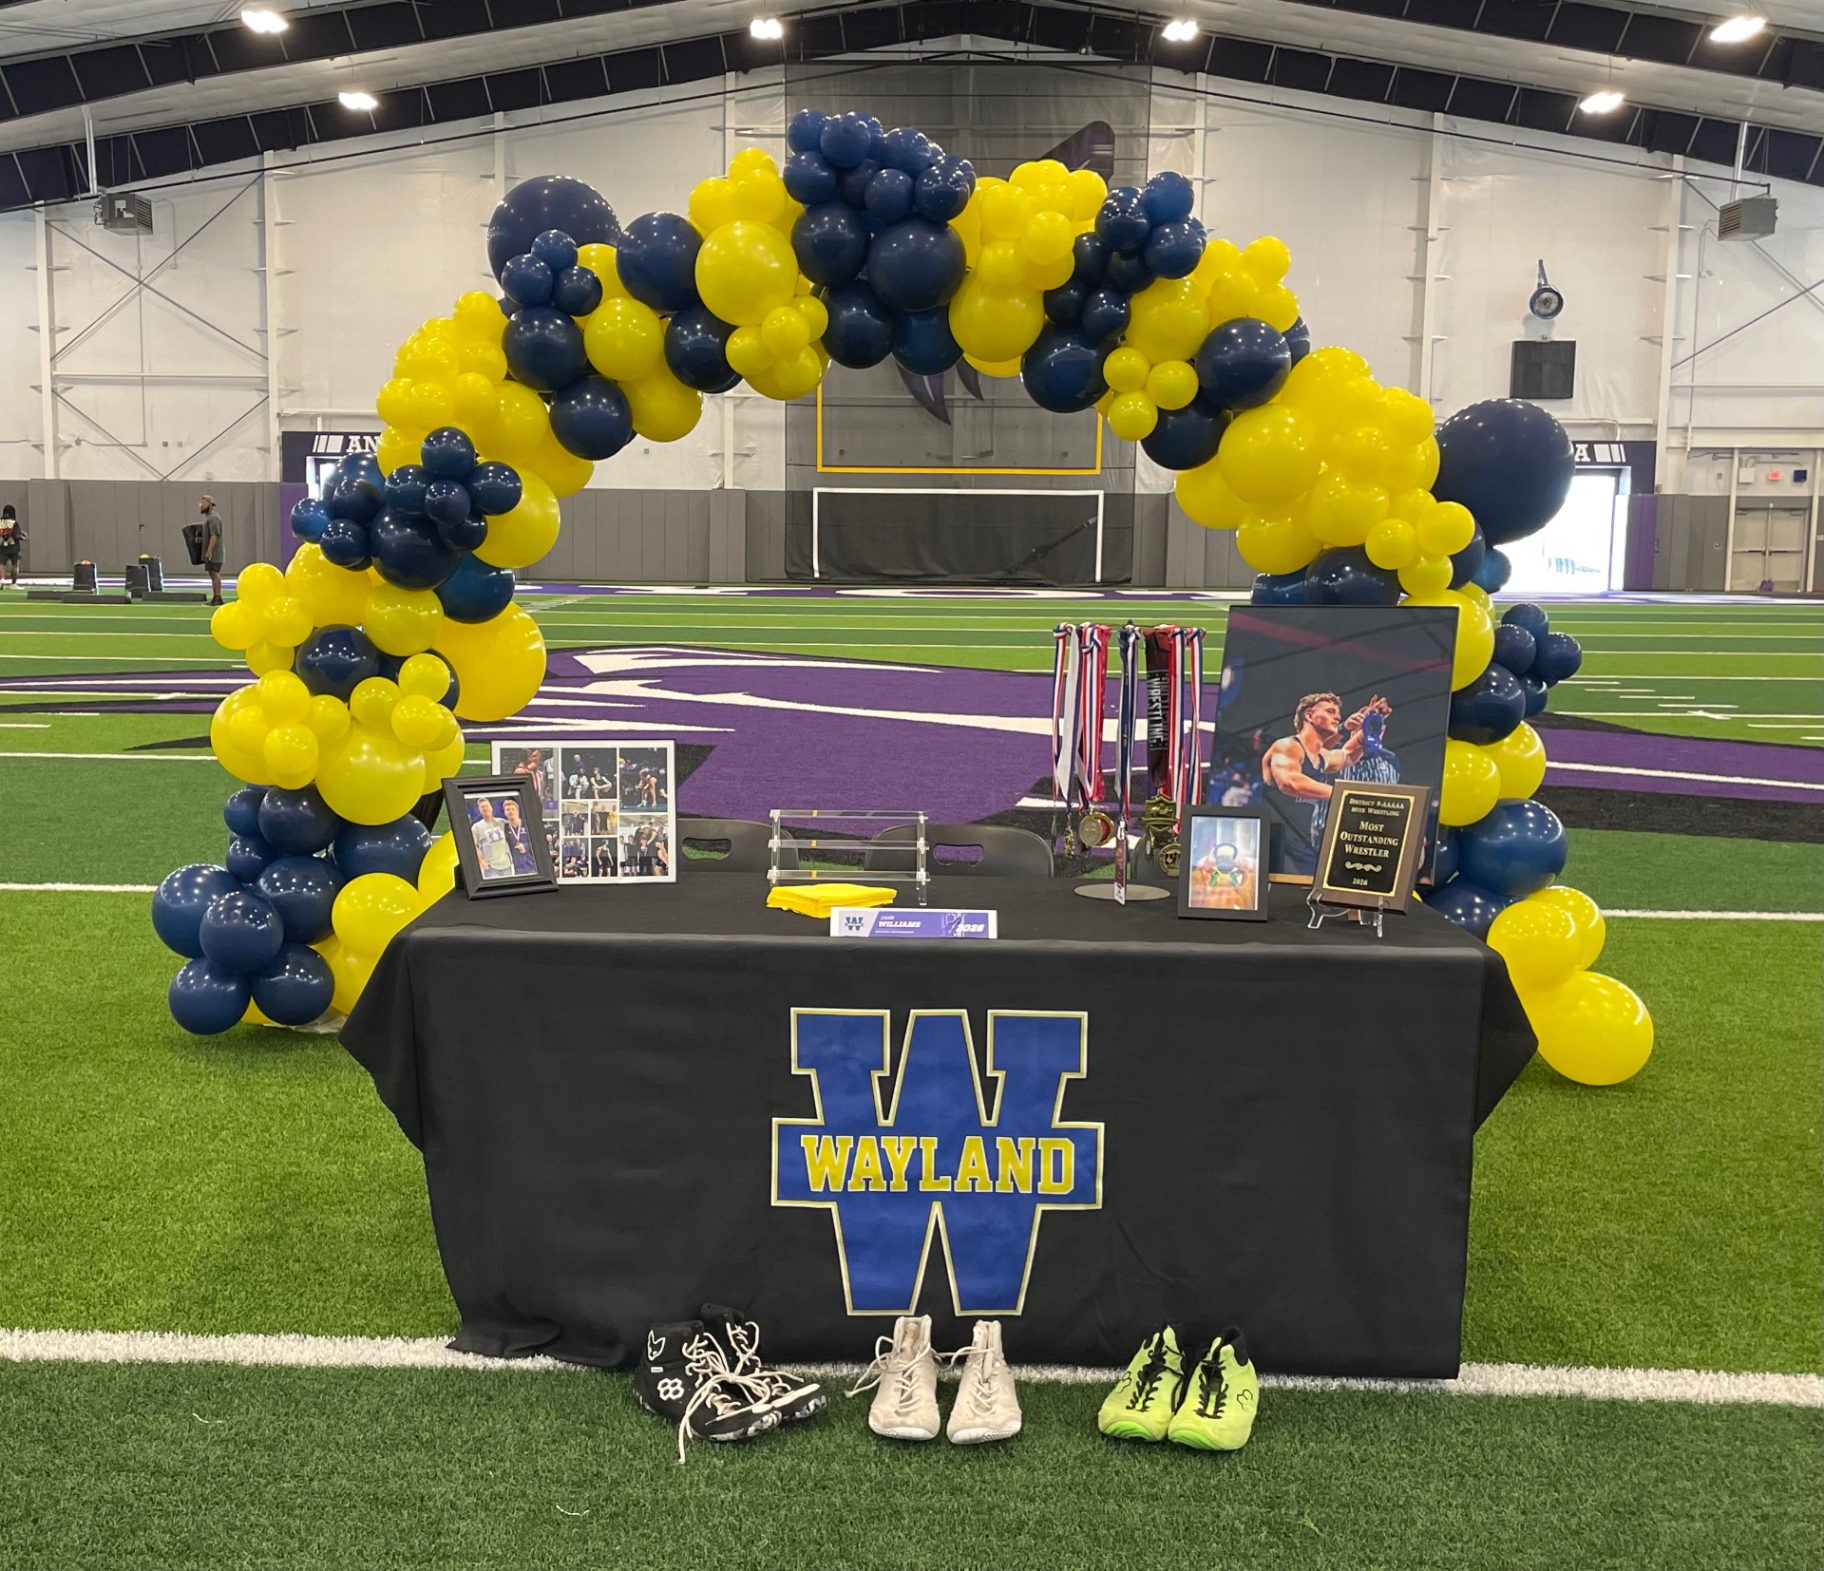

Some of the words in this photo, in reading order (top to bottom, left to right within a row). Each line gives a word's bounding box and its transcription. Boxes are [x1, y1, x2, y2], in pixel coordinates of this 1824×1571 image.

[1147, 677, 1164, 743] WRESTLING
[1349, 798, 1375, 806] DISTRICT
[1368, 808, 1399, 816] WRESTLING
[1359, 820, 1384, 832] MOST
[1340, 831, 1399, 846] OUTSTANDING
[1344, 844, 1389, 858] WRESTLER
[878, 920, 921, 928] WILLIAMS
[800, 1134, 1075, 1195] WAYLAND
